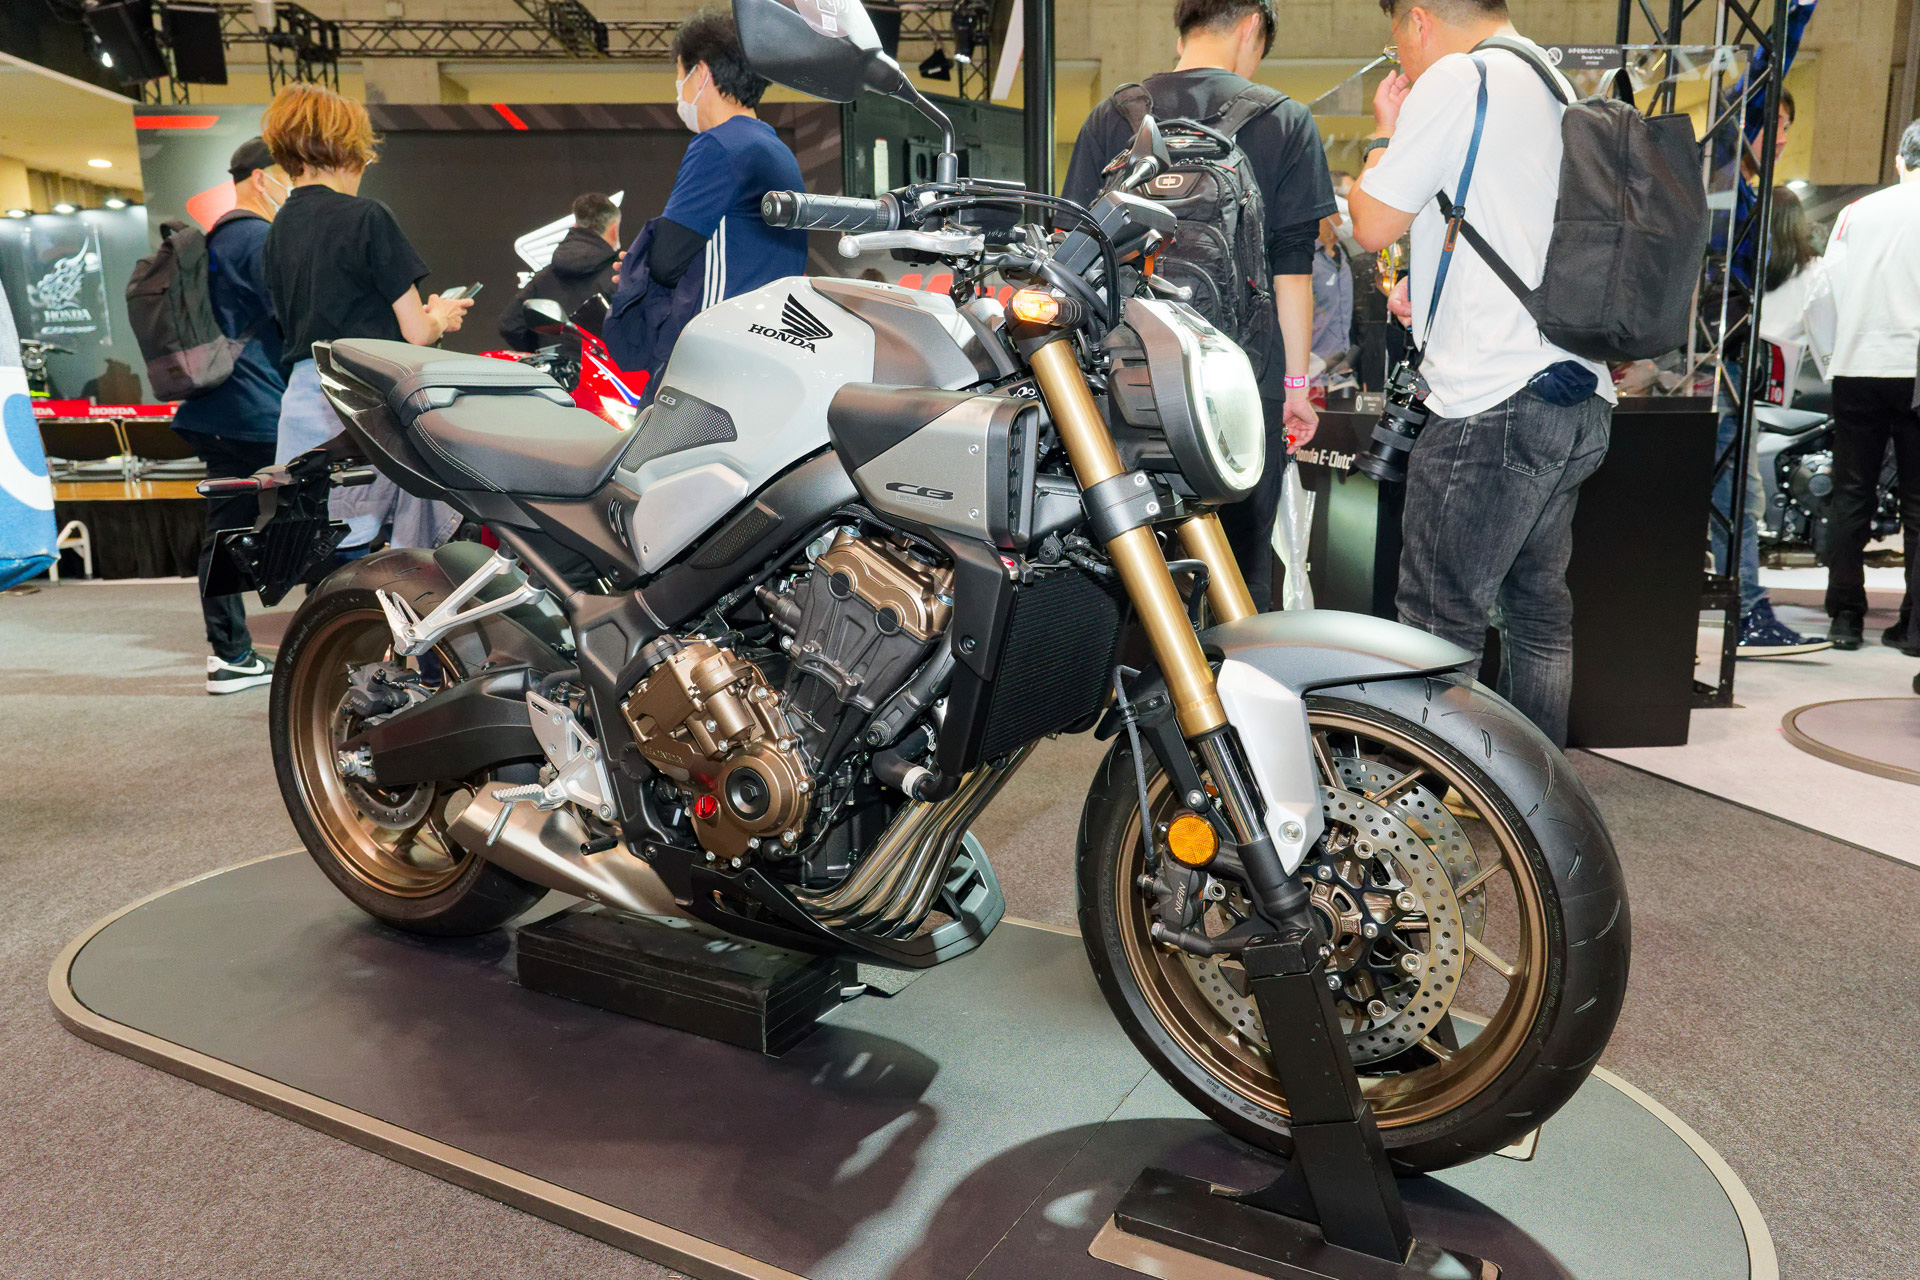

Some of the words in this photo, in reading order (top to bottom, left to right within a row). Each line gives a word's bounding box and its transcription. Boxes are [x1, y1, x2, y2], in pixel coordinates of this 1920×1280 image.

[747, 323, 817, 354] HONDA
[659, 394, 677, 406] CB
[88, 406, 138, 416] HONDA
[885, 481, 954, 501] CB
